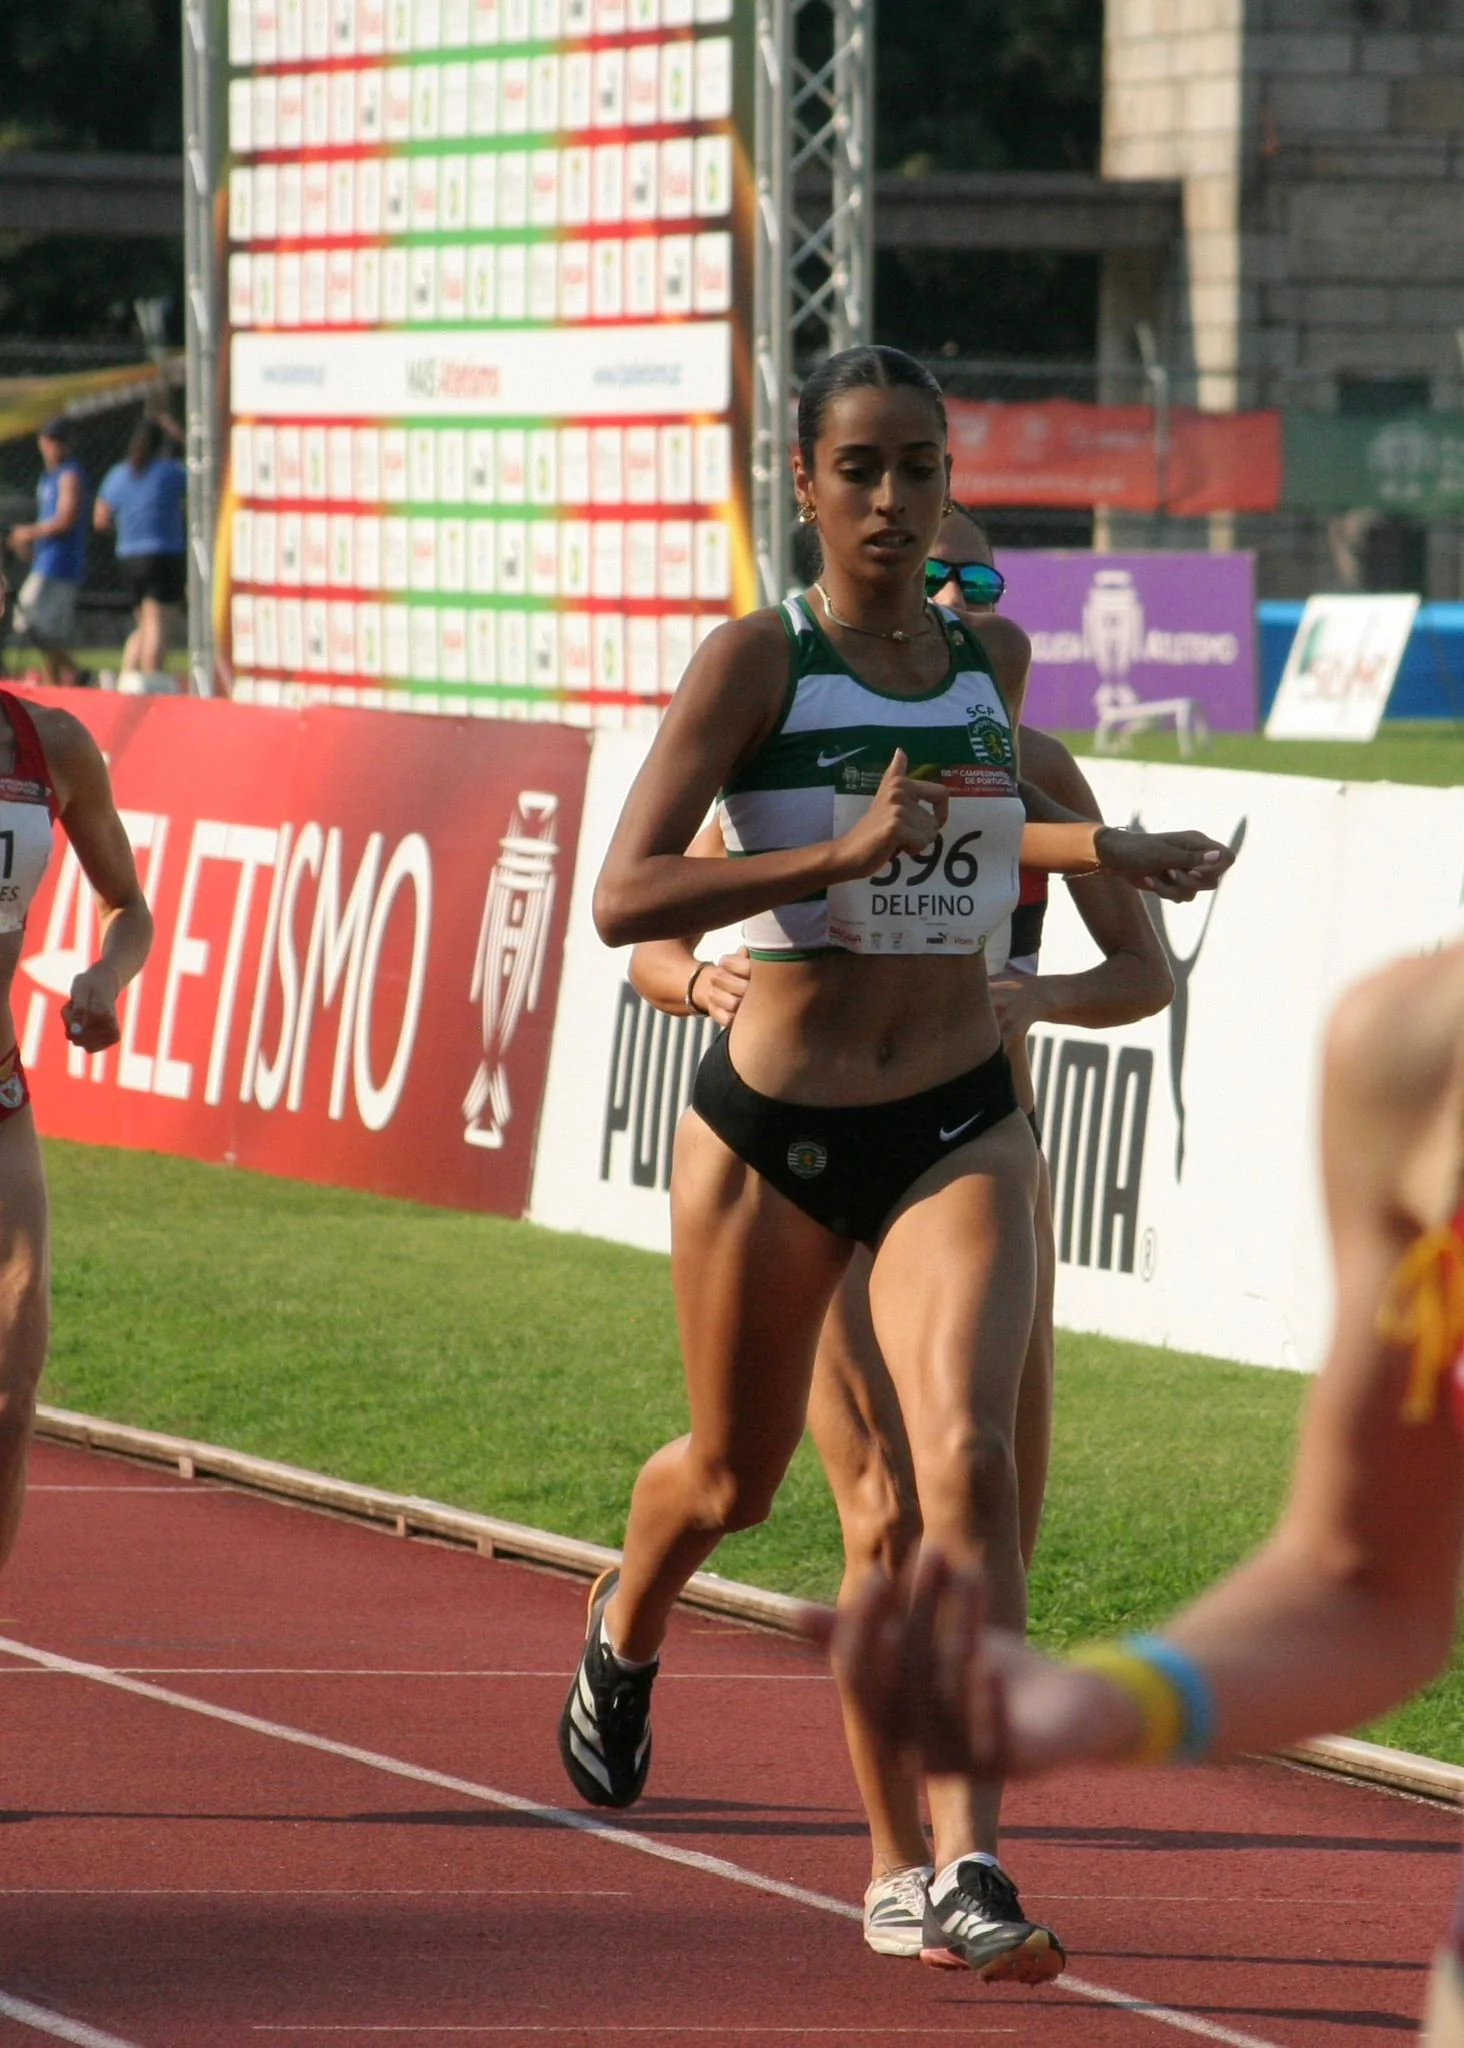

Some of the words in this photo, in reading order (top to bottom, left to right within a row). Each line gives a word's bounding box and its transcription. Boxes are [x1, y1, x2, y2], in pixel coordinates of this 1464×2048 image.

[966, 704, 995, 718] SCP
[871, 894, 974, 917] DELFINO
[1023, 1034, 1154, 1274] MA
